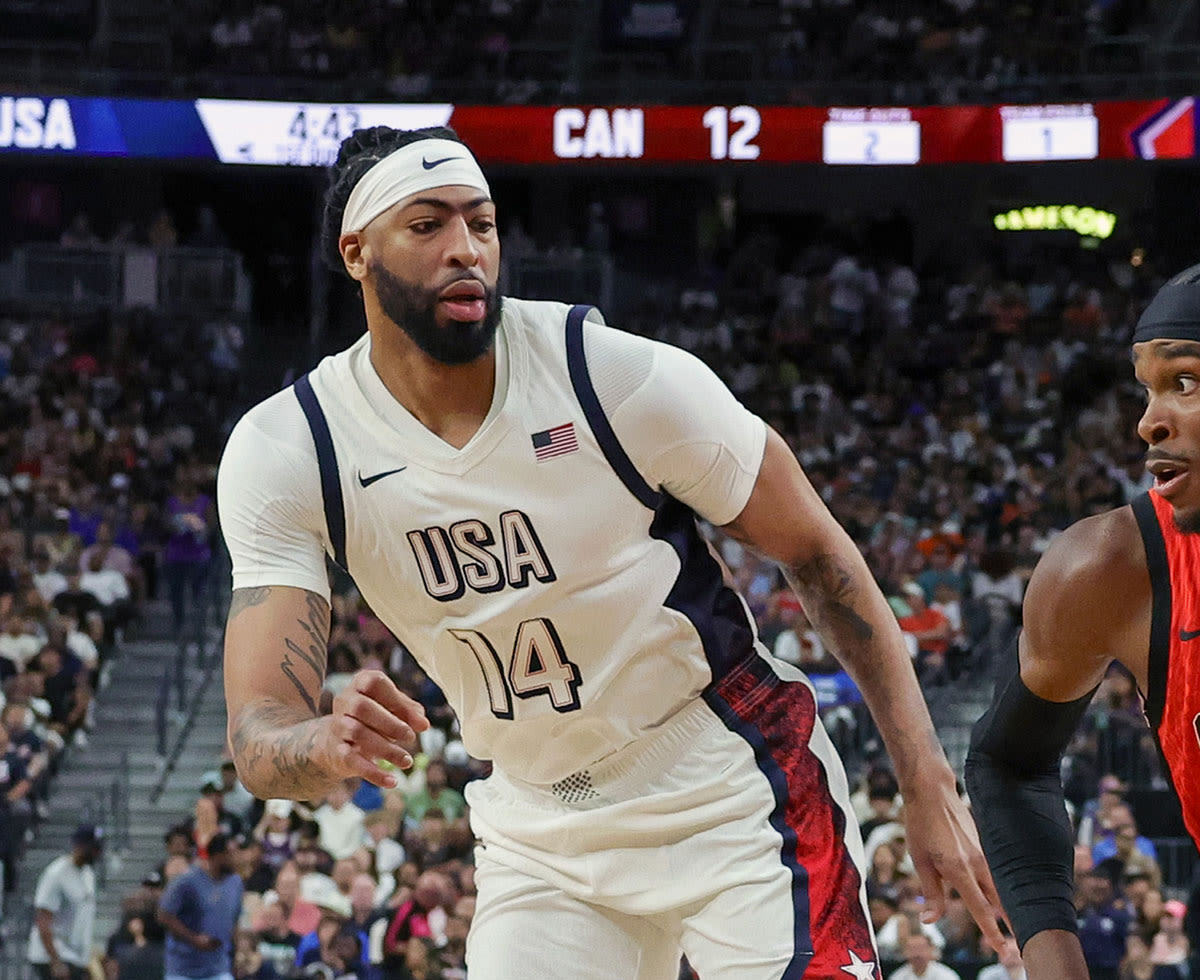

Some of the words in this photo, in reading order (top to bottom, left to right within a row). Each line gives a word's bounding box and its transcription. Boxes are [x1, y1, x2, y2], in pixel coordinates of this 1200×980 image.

[553, 107, 645, 158] CAN
[702, 105, 761, 160] 12
[864, 131, 879, 162] 2
[406, 509, 558, 602] USA
[446, 617, 584, 721] 14
